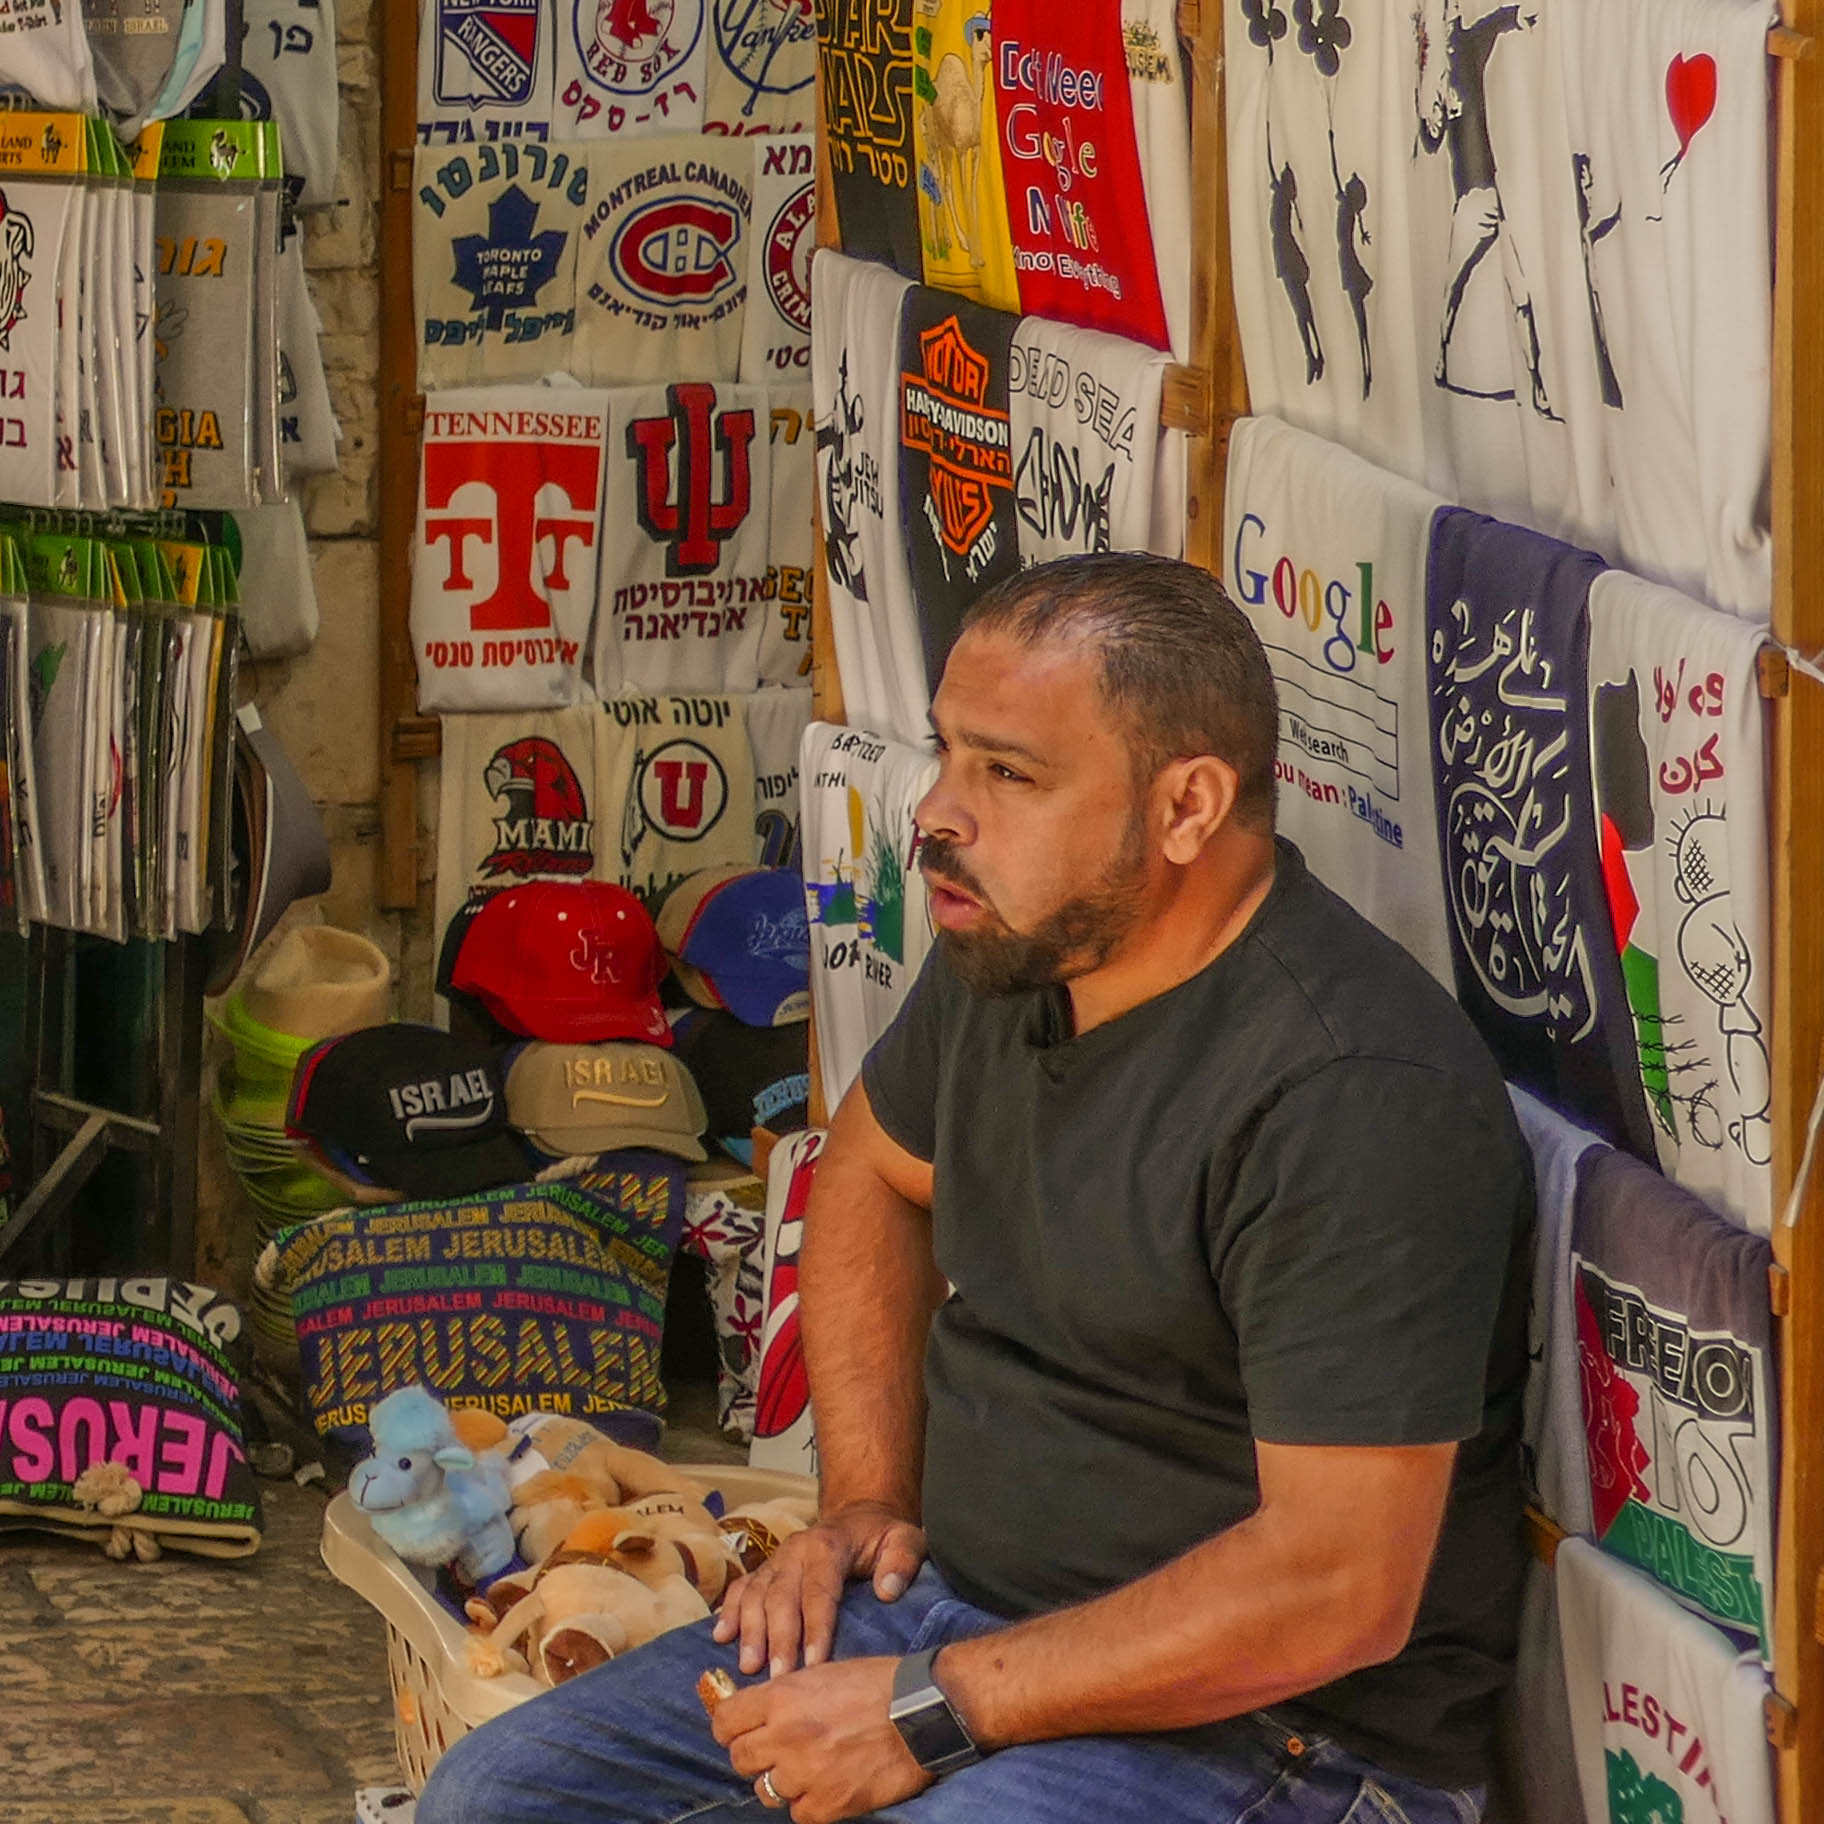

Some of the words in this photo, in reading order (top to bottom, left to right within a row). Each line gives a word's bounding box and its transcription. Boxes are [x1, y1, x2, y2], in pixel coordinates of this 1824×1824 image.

[585, 43, 628, 85] RED
[0, 135, 33, 150] LAND
[583, 162, 680, 241] MONTREAL
[476, 248, 542, 264] TORONTO
[425, 410, 601, 441] TENNESSEE
[1075, 371, 1137, 462] SEA
[1234, 513, 1396, 673] Google
[1272, 759, 1294, 785] ou
[388, 1069, 493, 1120] ISRAEL
[563, 1059, 667, 1088] ISRAEL
[526, 1183, 630, 1234] JERUSALEM
[443, 1228, 622, 1275] JERUSALEM
[363, 1292, 482, 1321] JERUSALEM
[492, 1290, 605, 1323] JERUSALEM
[30, 1356, 150, 1380] JERUSALEM
[308, 1313, 669, 1409] JERUSALEM
